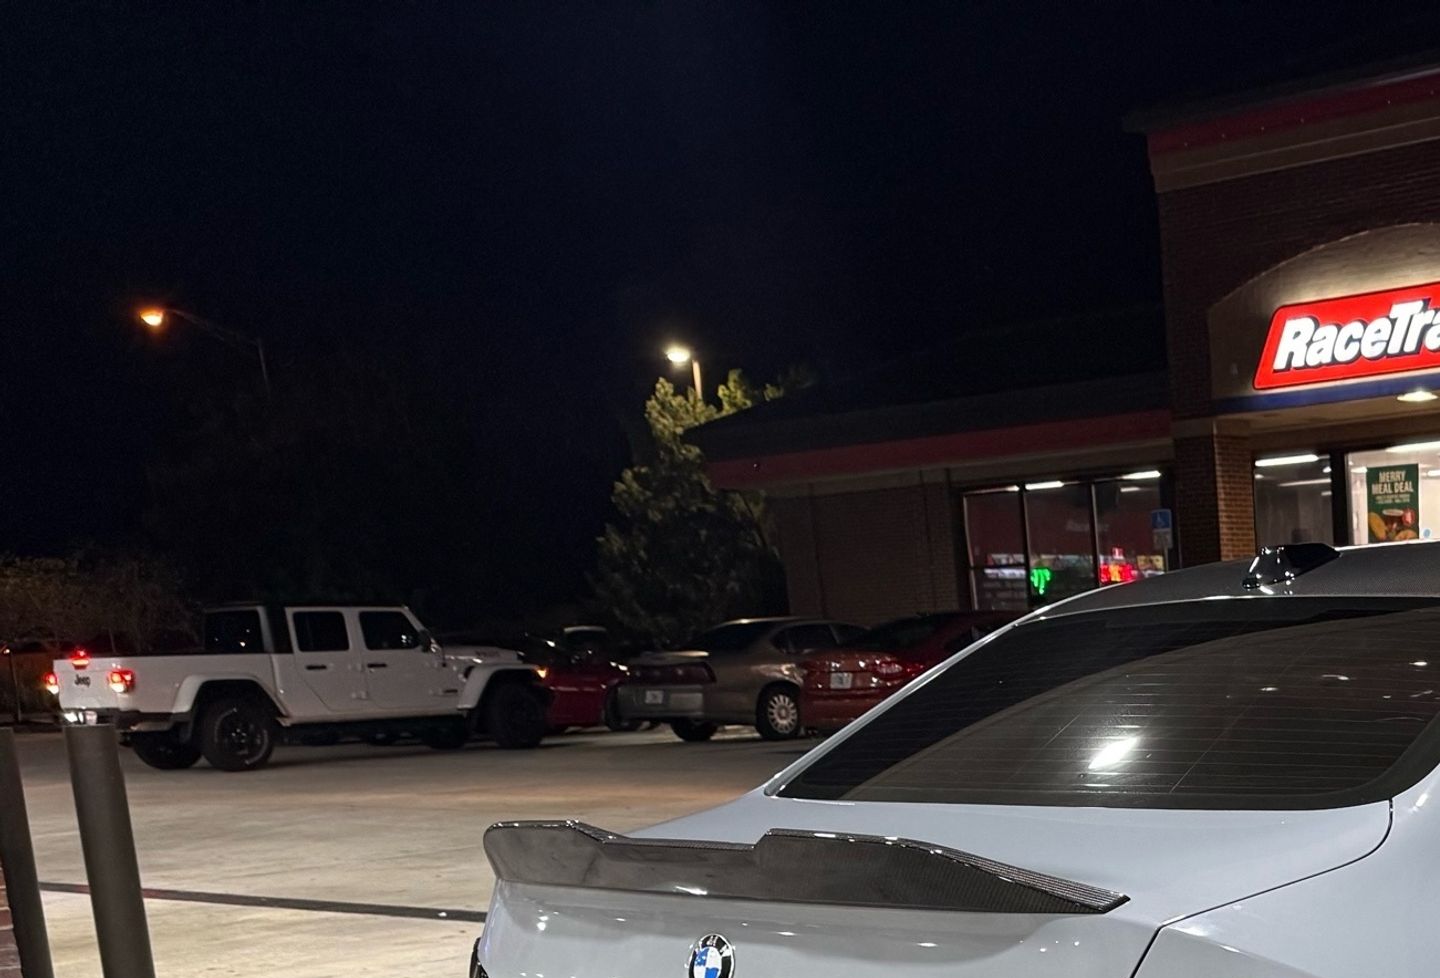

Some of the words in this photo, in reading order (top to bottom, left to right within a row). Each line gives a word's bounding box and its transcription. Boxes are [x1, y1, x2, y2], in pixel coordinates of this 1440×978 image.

[1379, 470, 1406, 483] MERRY
[1371, 483, 1392, 495] MEAL
[1394, 481, 1413, 493] DEAL
